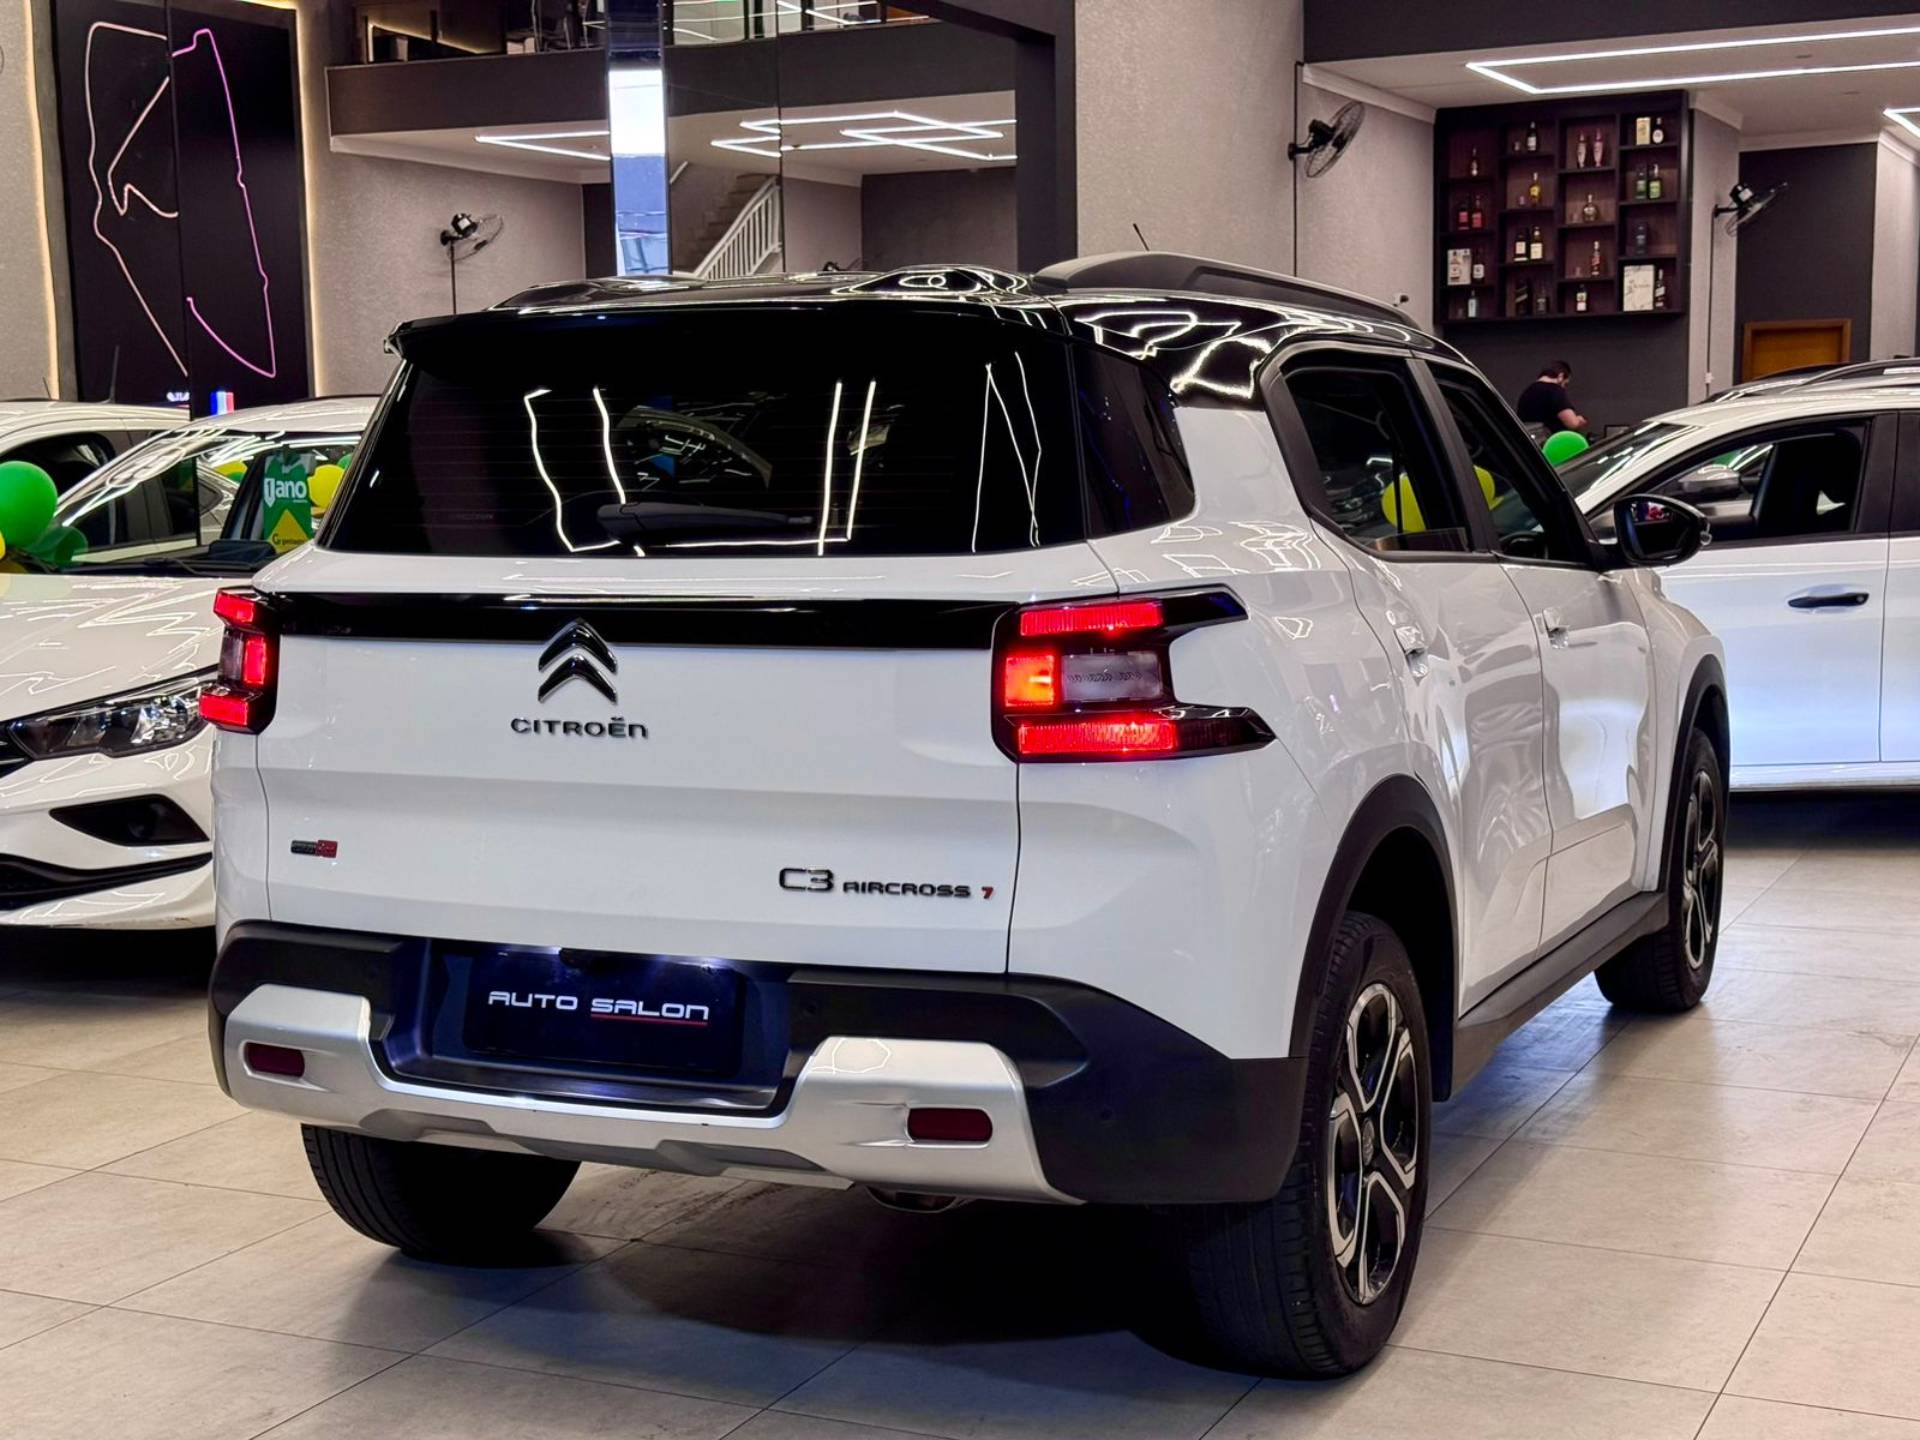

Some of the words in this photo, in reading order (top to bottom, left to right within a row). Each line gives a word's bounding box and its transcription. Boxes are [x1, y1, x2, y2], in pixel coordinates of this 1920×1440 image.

[779, 867, 834, 892] C3
[843, 881, 971, 898] AIRCROSS
[981, 886, 994, 899] 7
[488, 991, 578, 1010] AUTO
